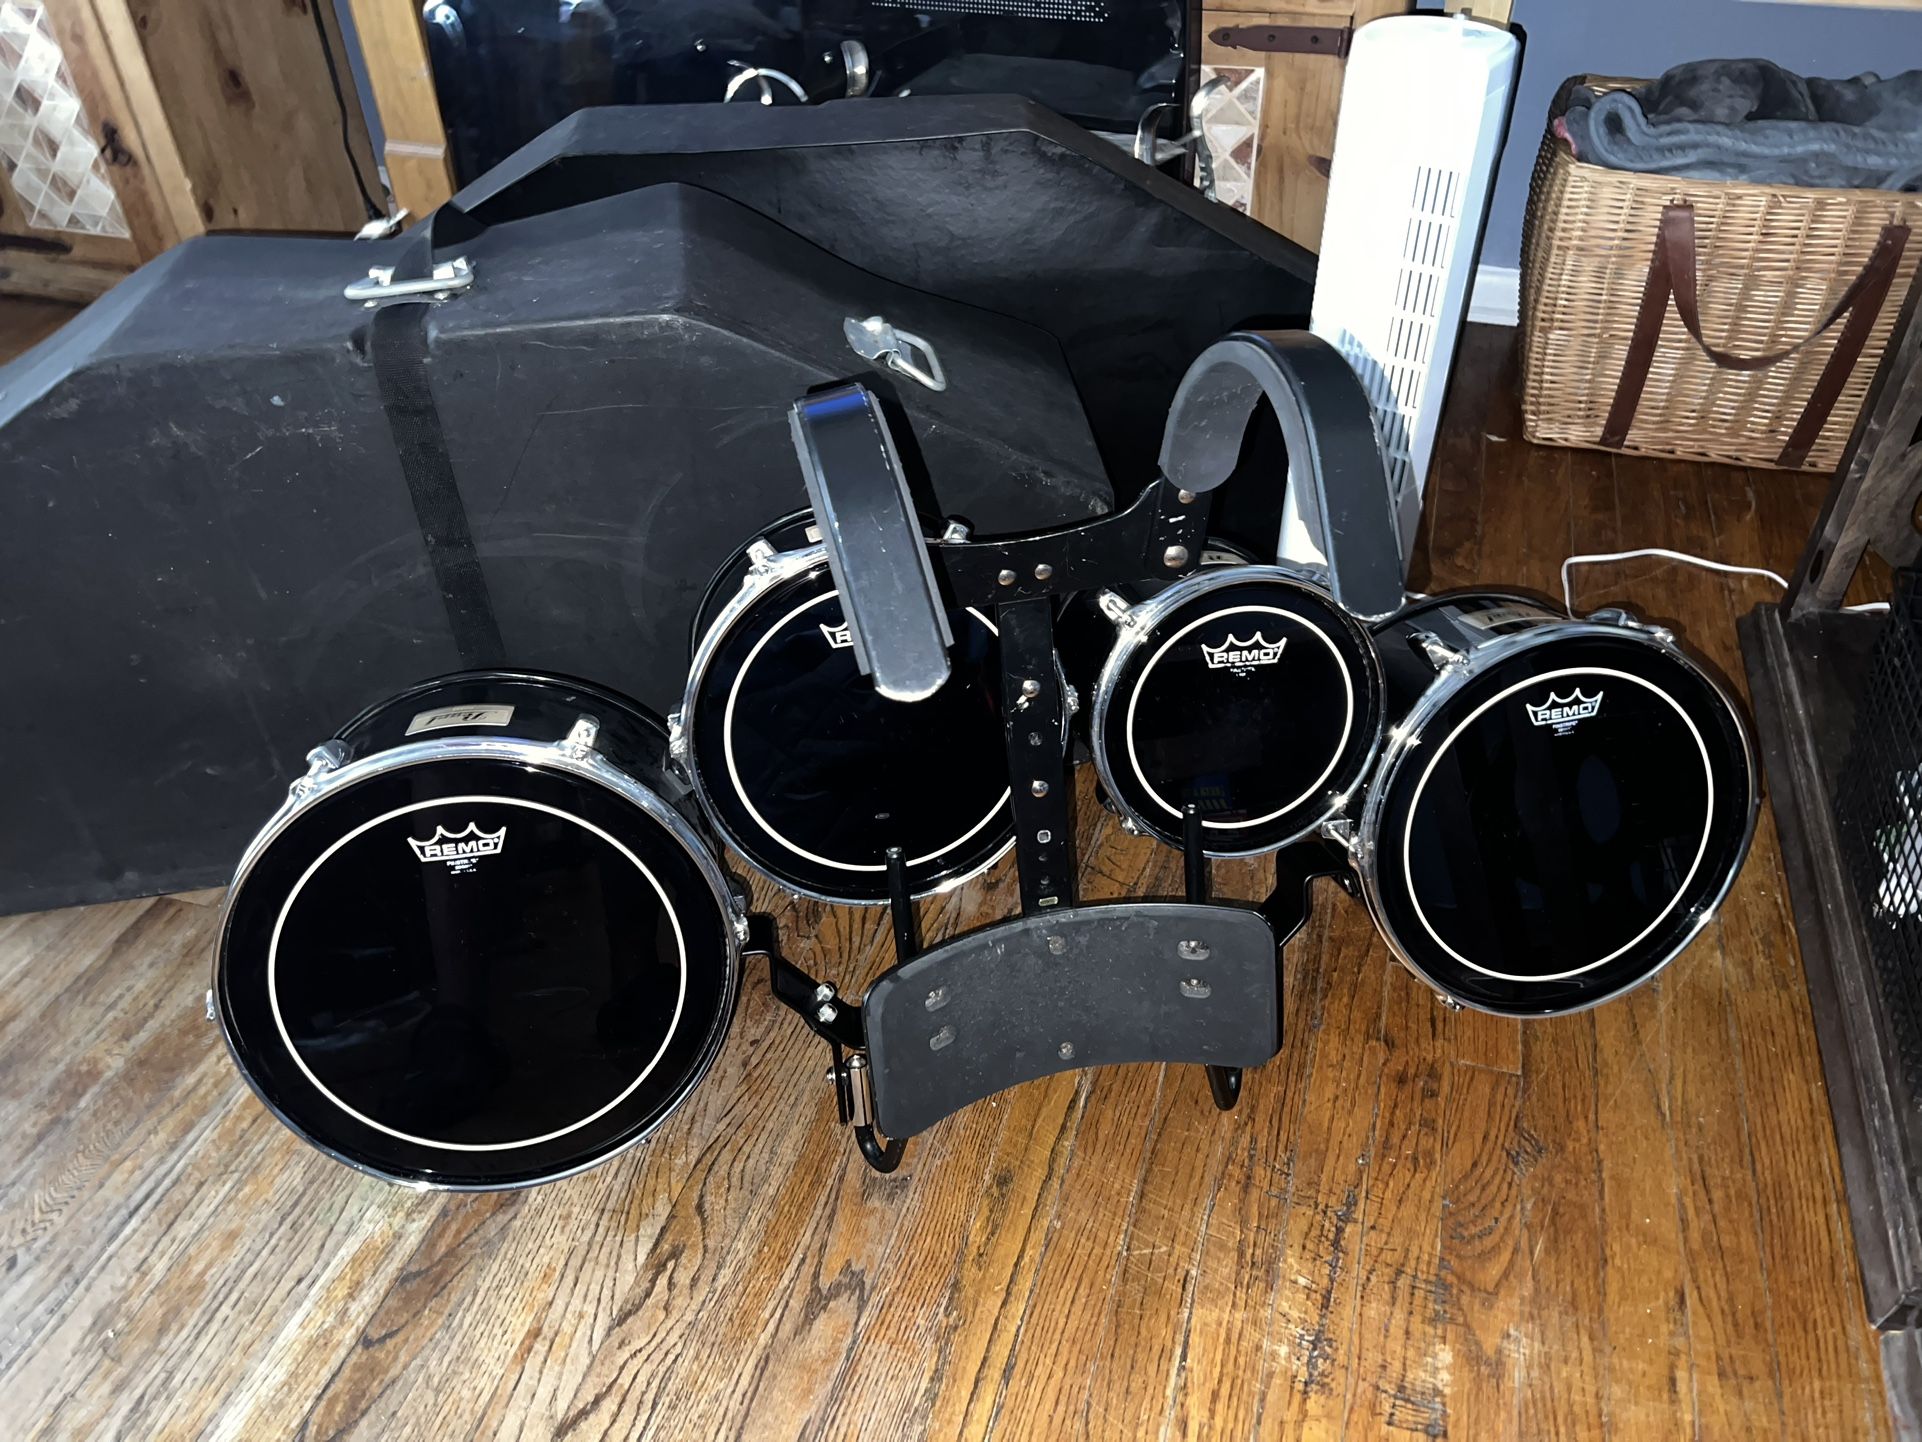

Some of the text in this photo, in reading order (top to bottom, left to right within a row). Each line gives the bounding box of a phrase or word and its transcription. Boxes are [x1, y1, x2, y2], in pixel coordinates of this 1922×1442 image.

[1213, 648, 1274, 664] REMO
[1537, 702, 1592, 721] REMO
[424, 839, 494, 858] REMO
